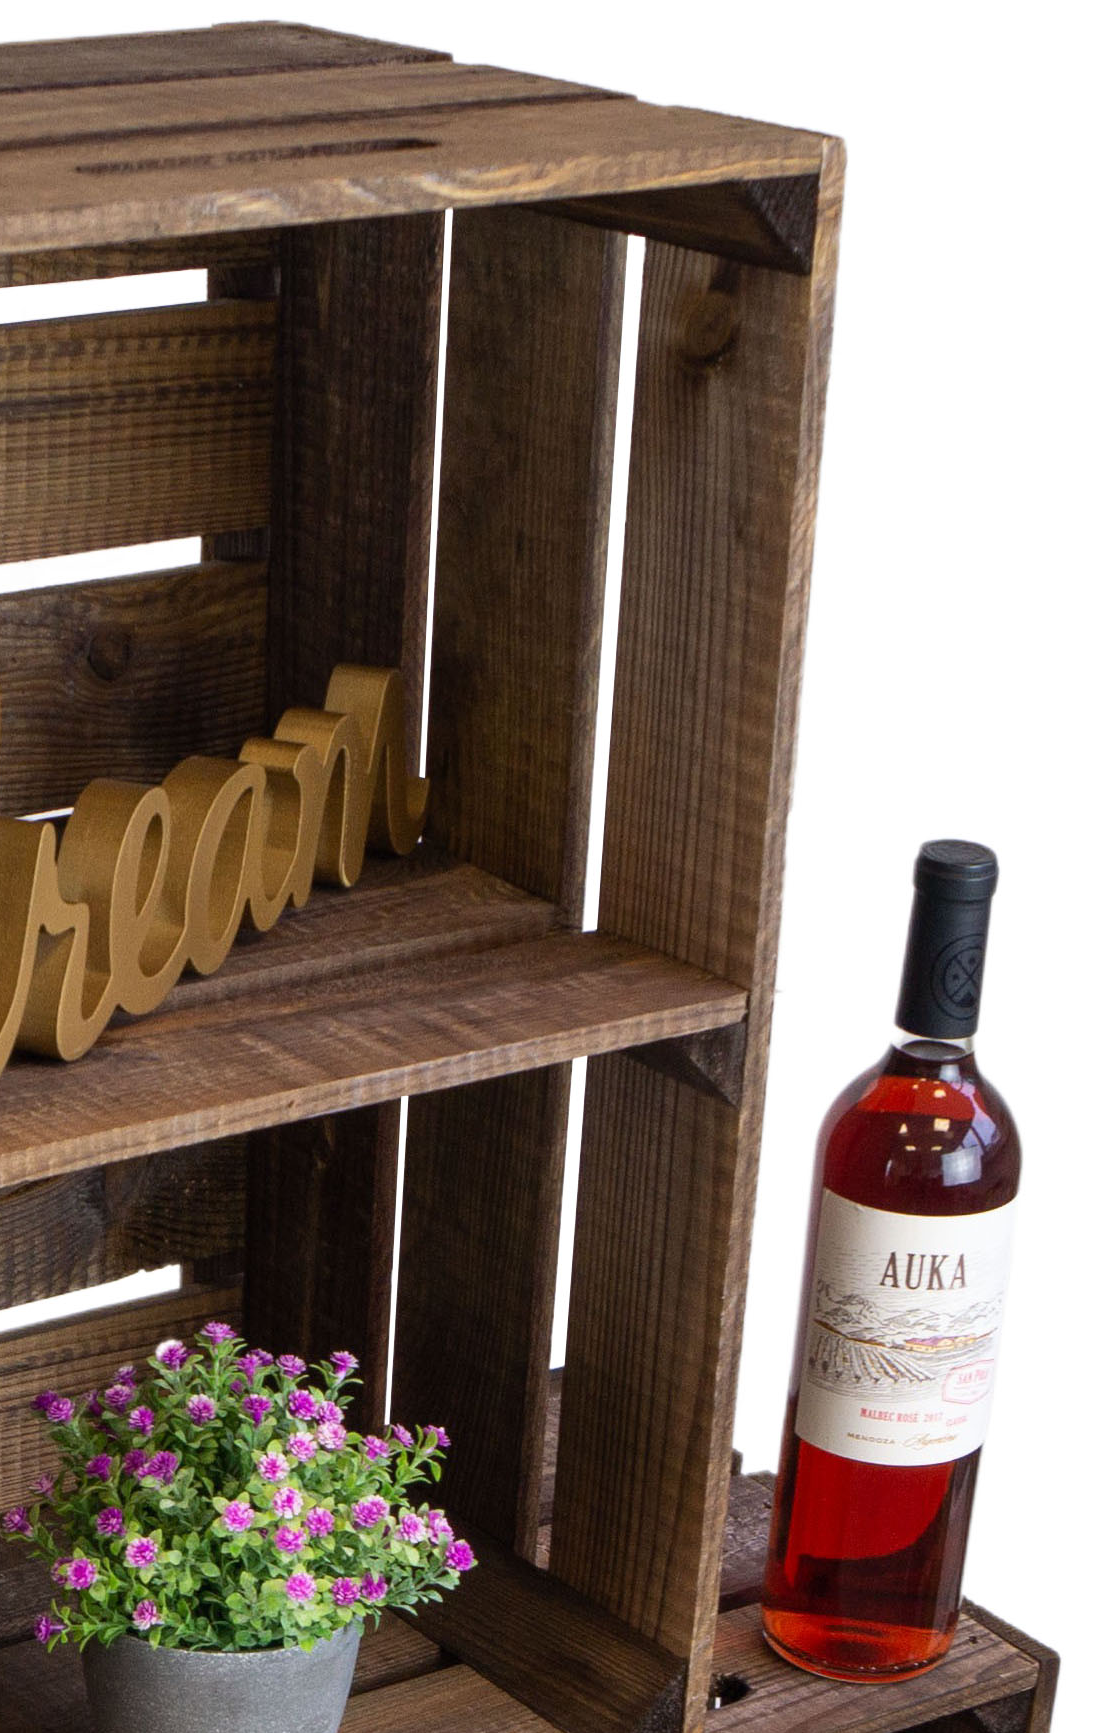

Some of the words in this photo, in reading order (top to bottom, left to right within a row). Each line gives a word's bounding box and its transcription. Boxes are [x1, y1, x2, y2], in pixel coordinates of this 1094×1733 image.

[879, 1251, 968, 1291] AUKA
[859, 1407, 895, 1422] MALBEC
[847, 1432, 895, 1444] MENDOZA
